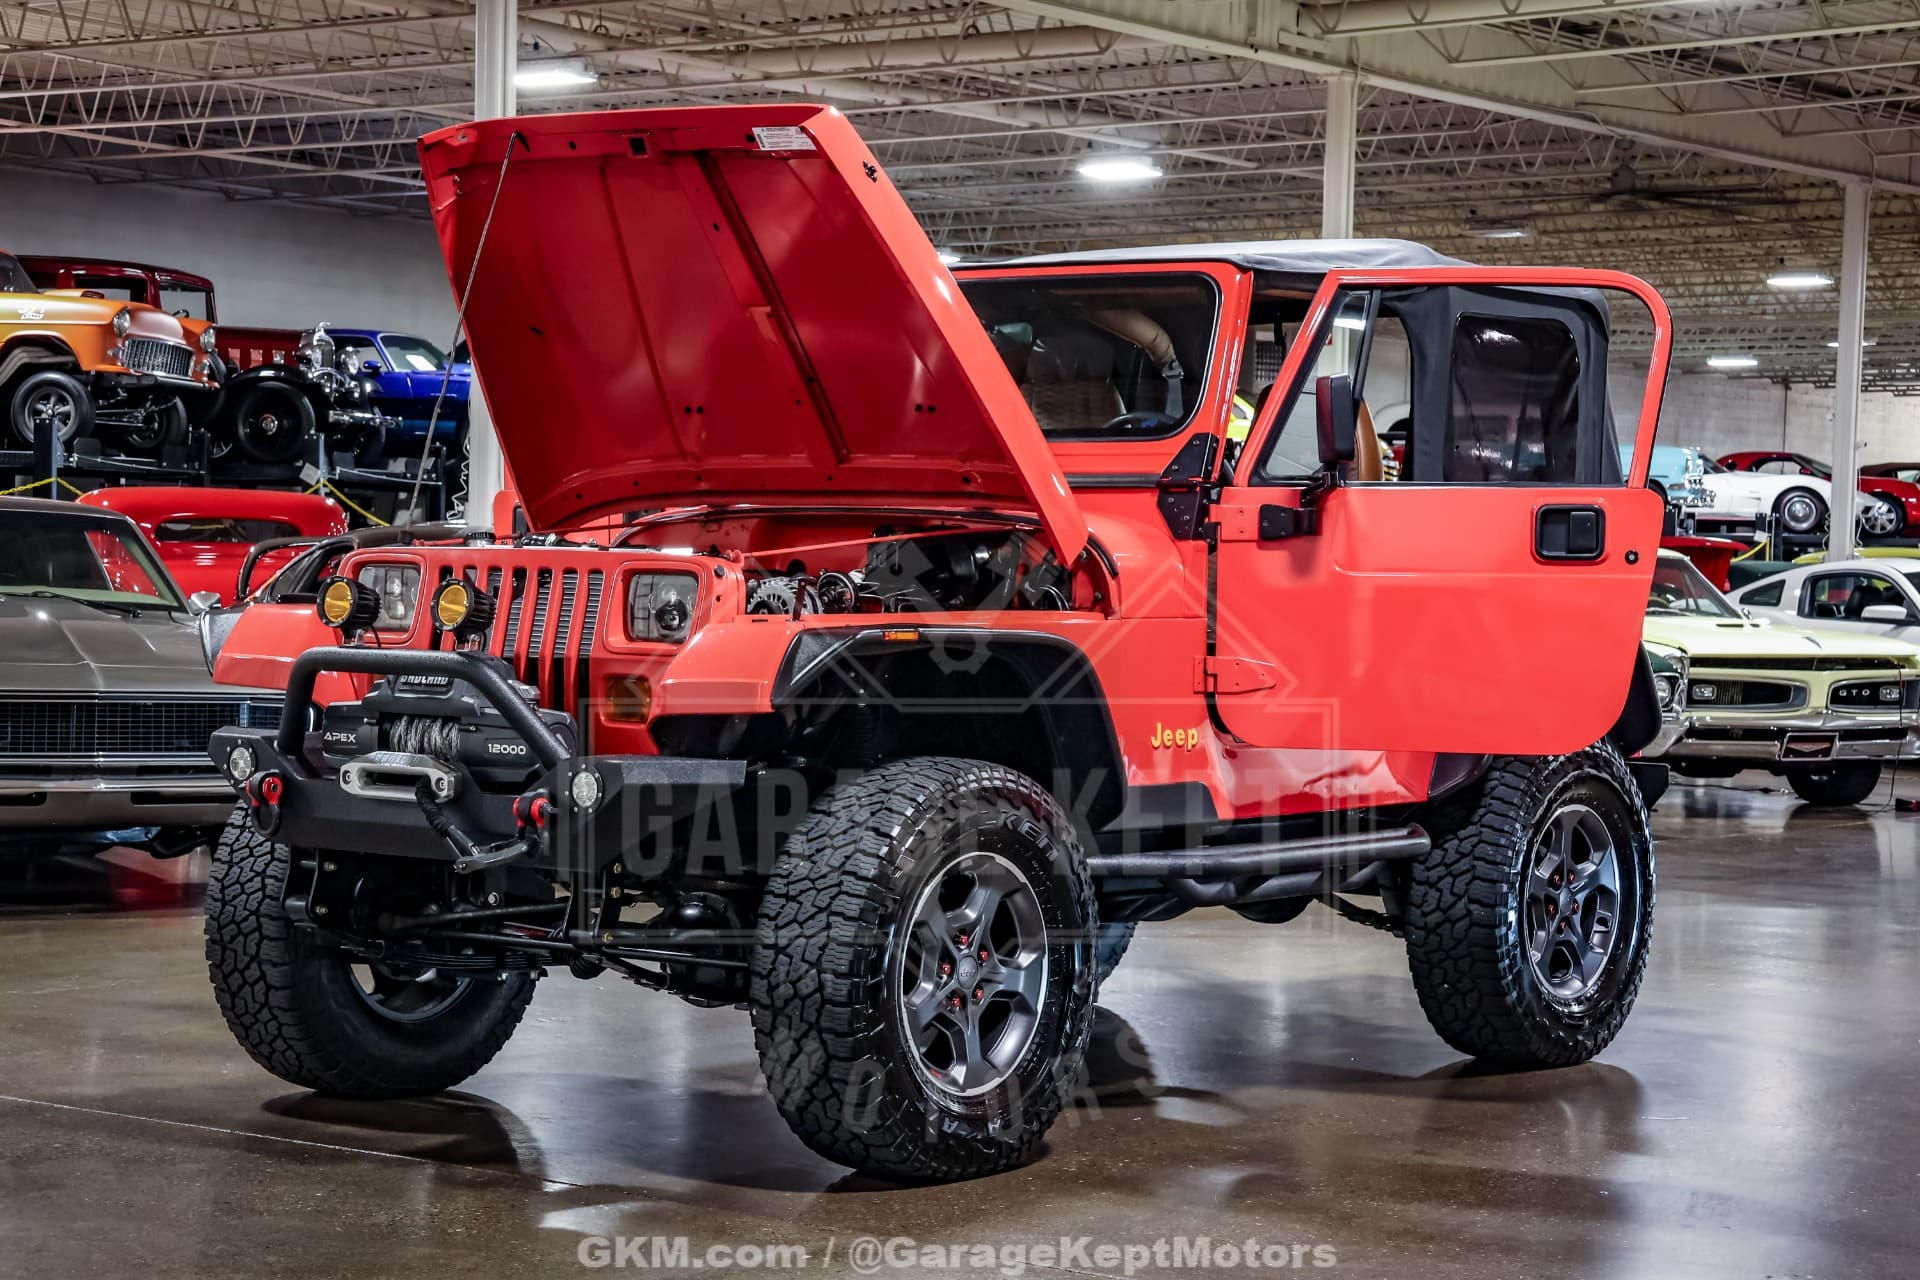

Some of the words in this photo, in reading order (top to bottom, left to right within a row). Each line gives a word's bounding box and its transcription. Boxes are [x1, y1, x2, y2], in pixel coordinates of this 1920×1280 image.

[323, 731, 357, 744] APEX
[1151, 722, 1198, 752] Jeep
[487, 743, 527, 755] 12000
